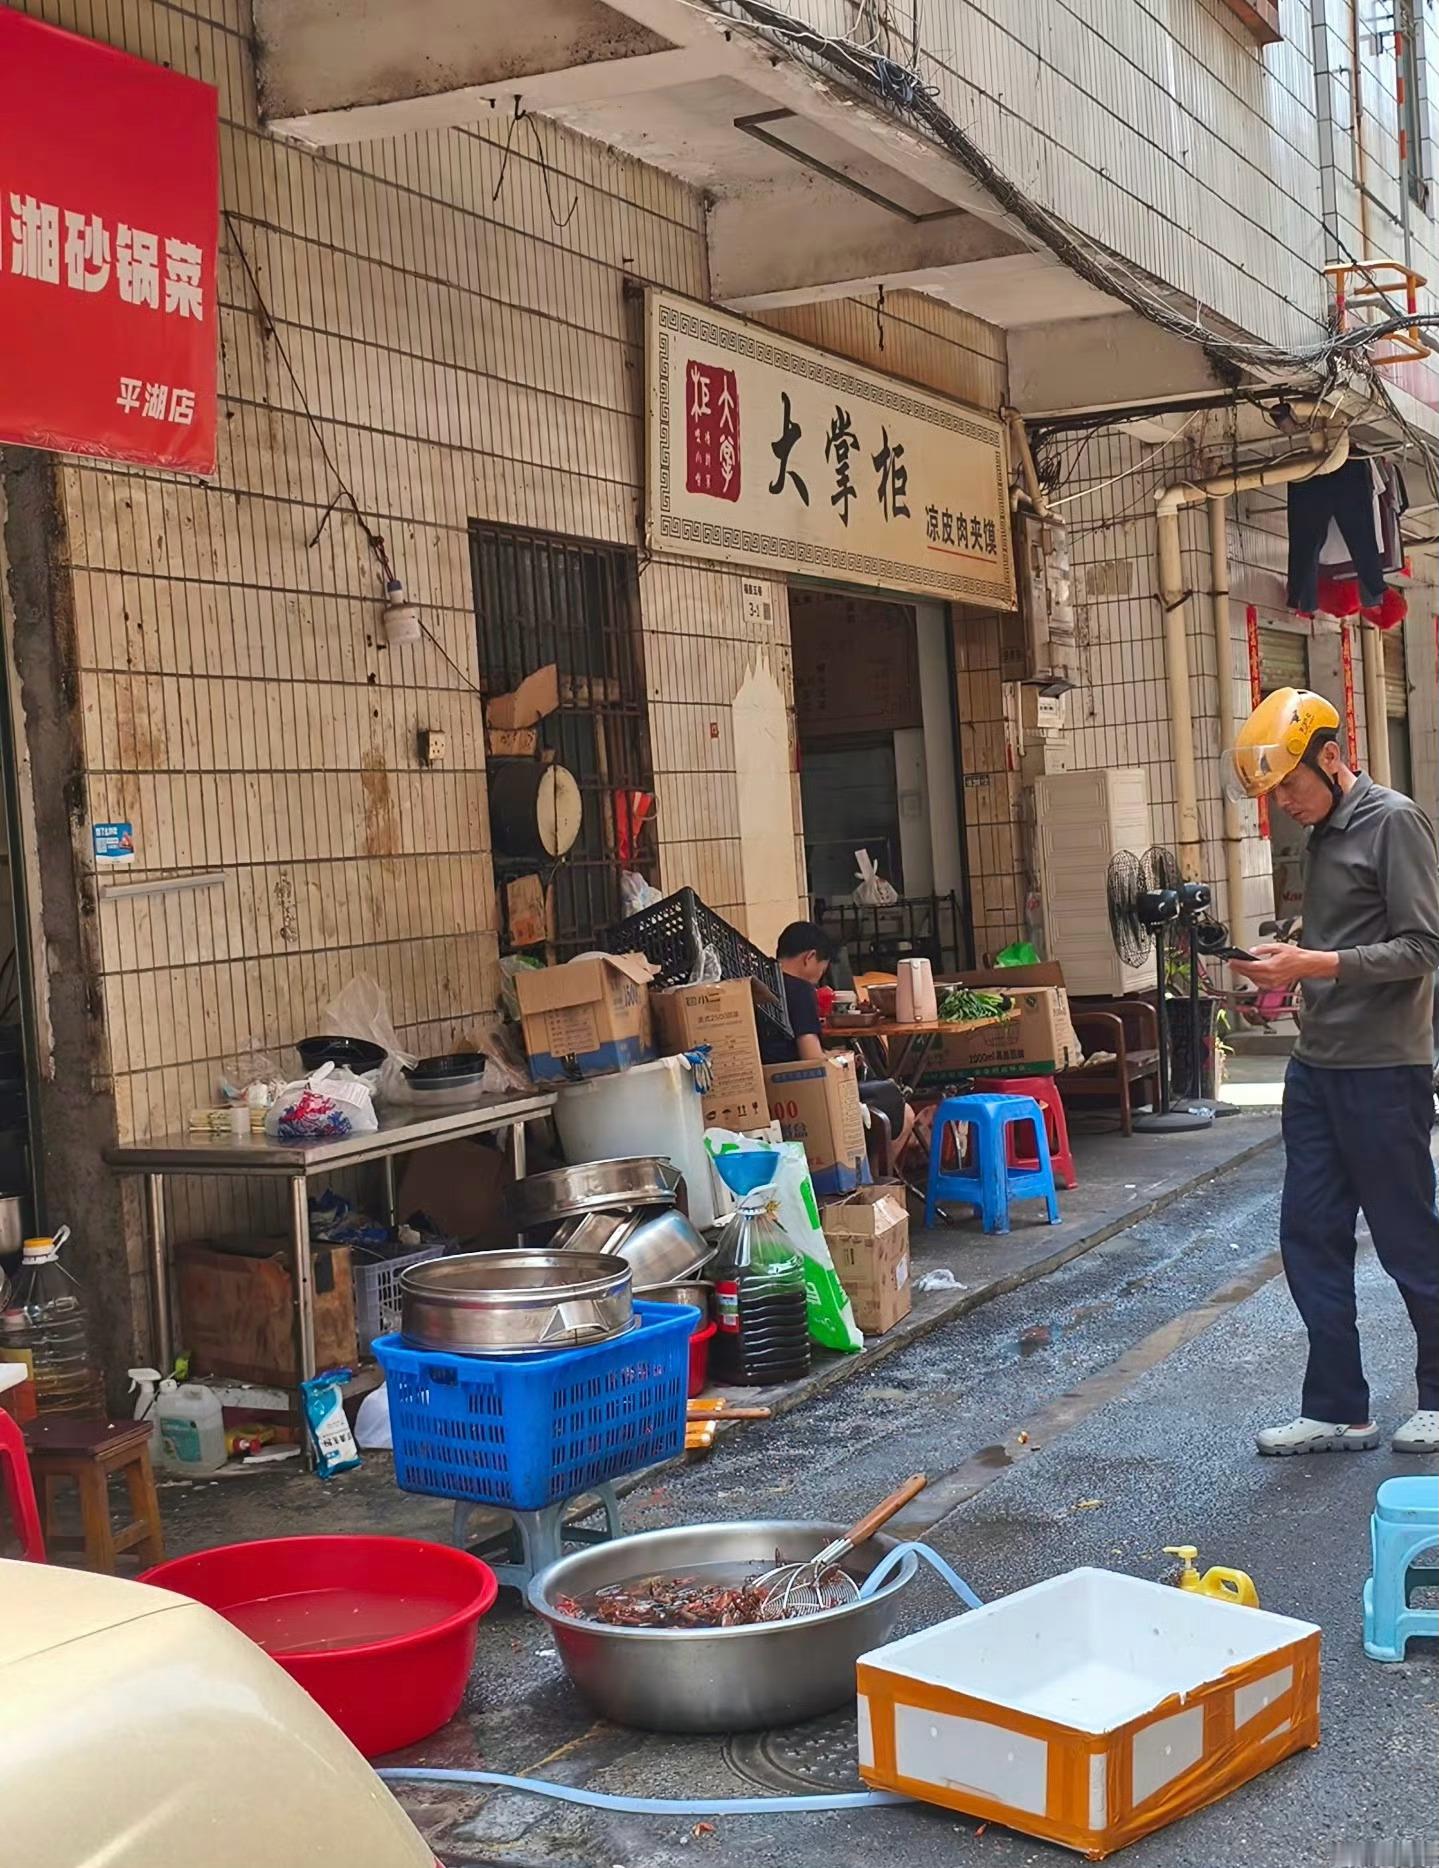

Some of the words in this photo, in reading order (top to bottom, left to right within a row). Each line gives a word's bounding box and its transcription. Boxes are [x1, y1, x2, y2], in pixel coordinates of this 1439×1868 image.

[0, 190, 203, 321] 湘砂锅菜
[116, 376, 196, 425] 平湖店
[768, 391, 911, 527] 大掌柜
[925, 504, 997, 555] 凉皮肉夹馍
[748, 602, 760, 617] 3-1
